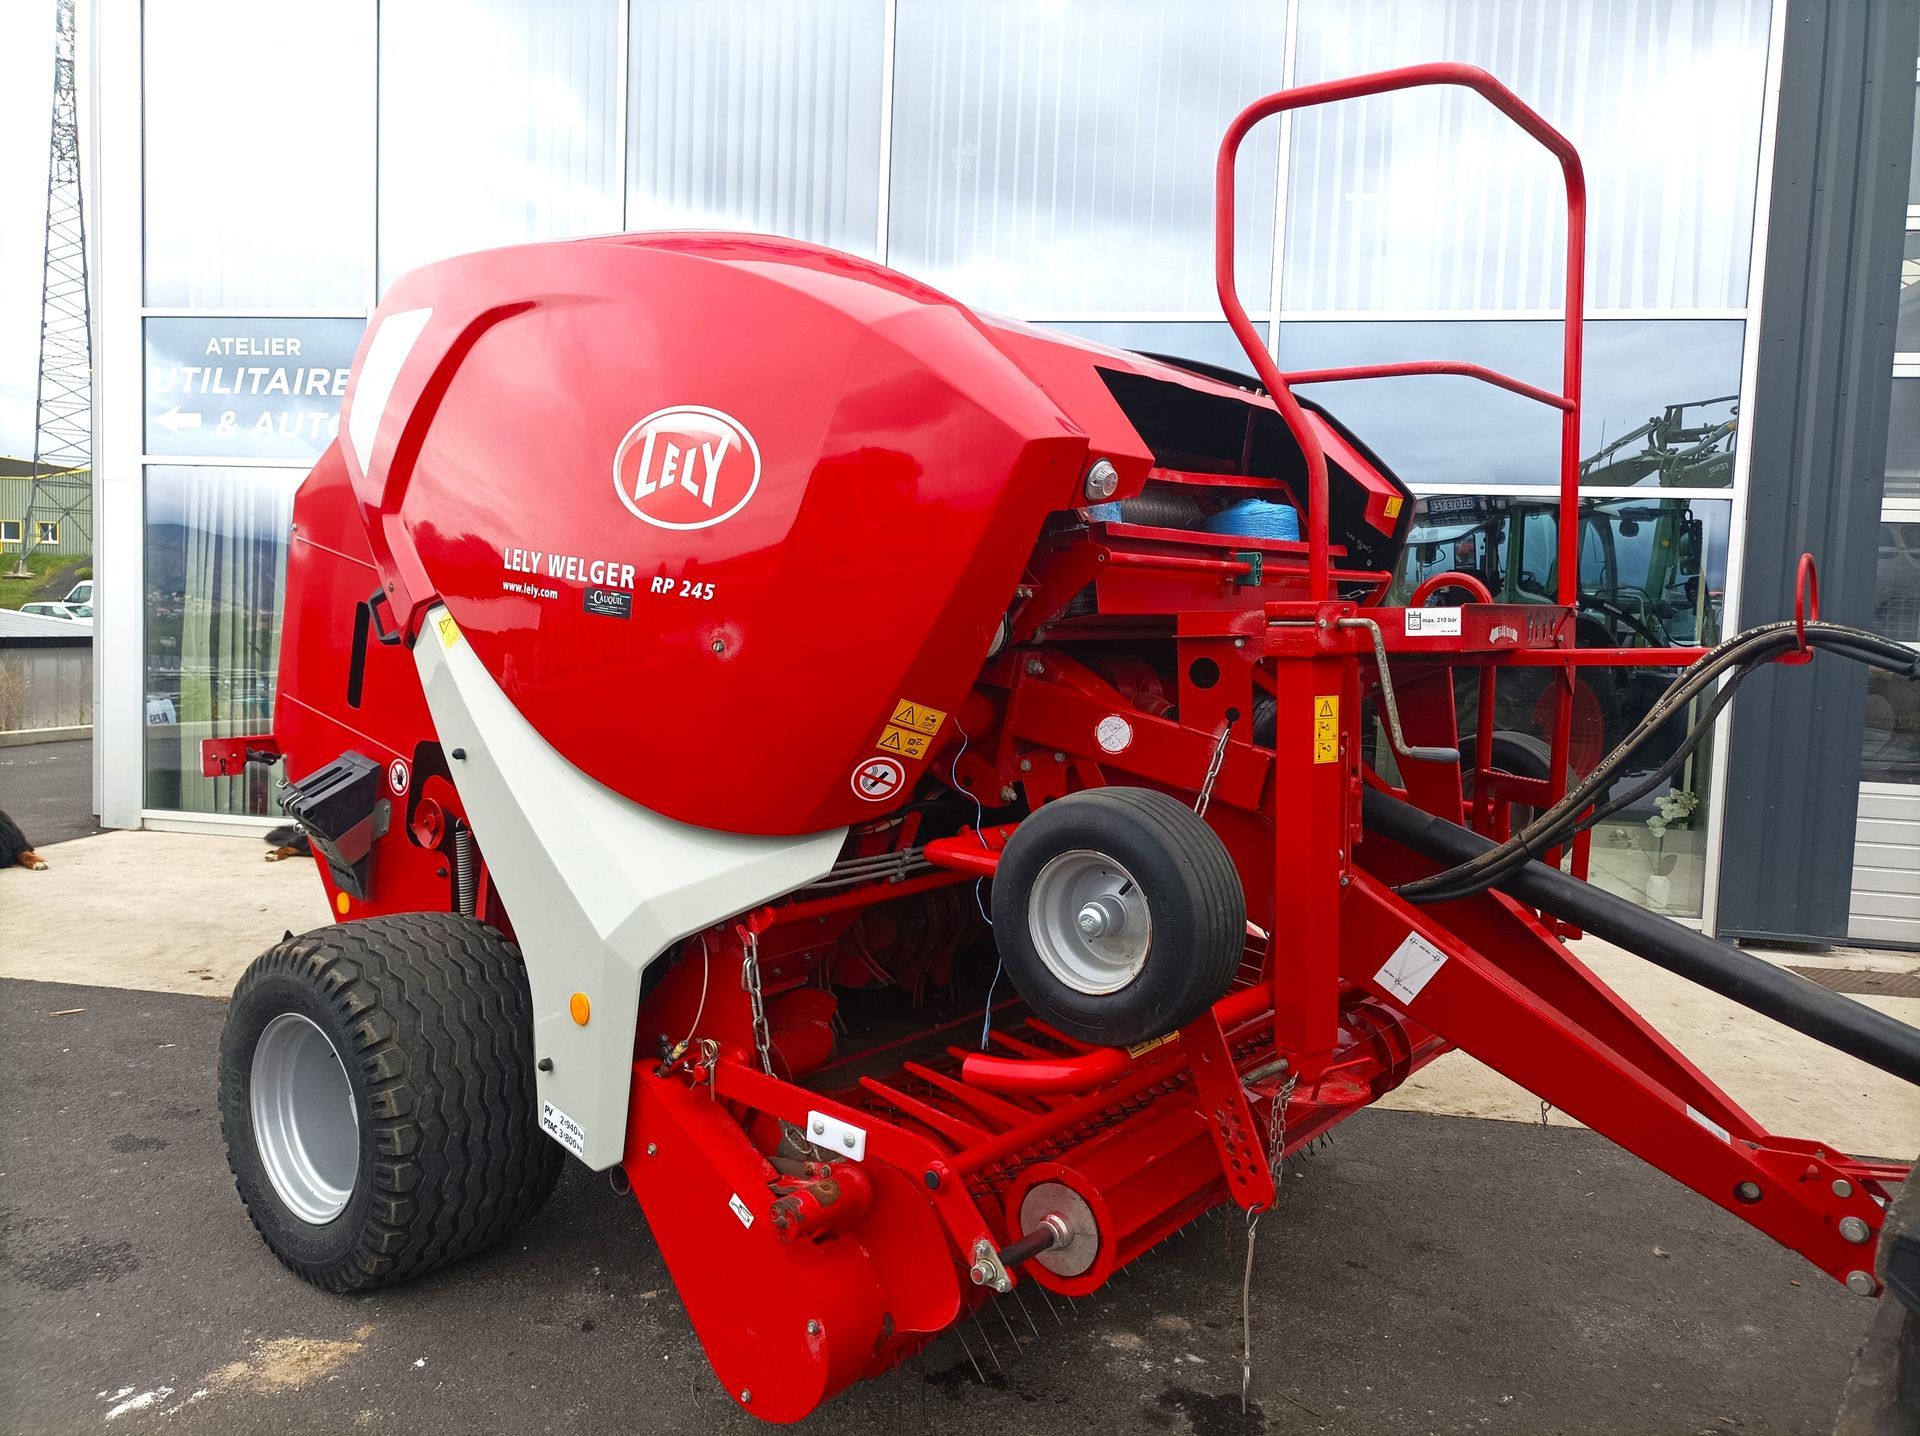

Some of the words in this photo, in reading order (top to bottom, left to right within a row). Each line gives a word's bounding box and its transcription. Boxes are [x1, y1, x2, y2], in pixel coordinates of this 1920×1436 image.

[205, 337, 302, 355] ATELIER
[215, 409, 239, 437] &
[633, 427, 733, 509] LELY
[503, 547, 543, 574] LELY
[548, 553, 636, 589] WELGER
[502, 580, 558, 600] www.lely.com
[650, 576, 675, 595] RP
[679, 580, 716, 601] 245
[545, 1104, 553, 1116] PV
[544, 1117, 557, 1134] PTAC
